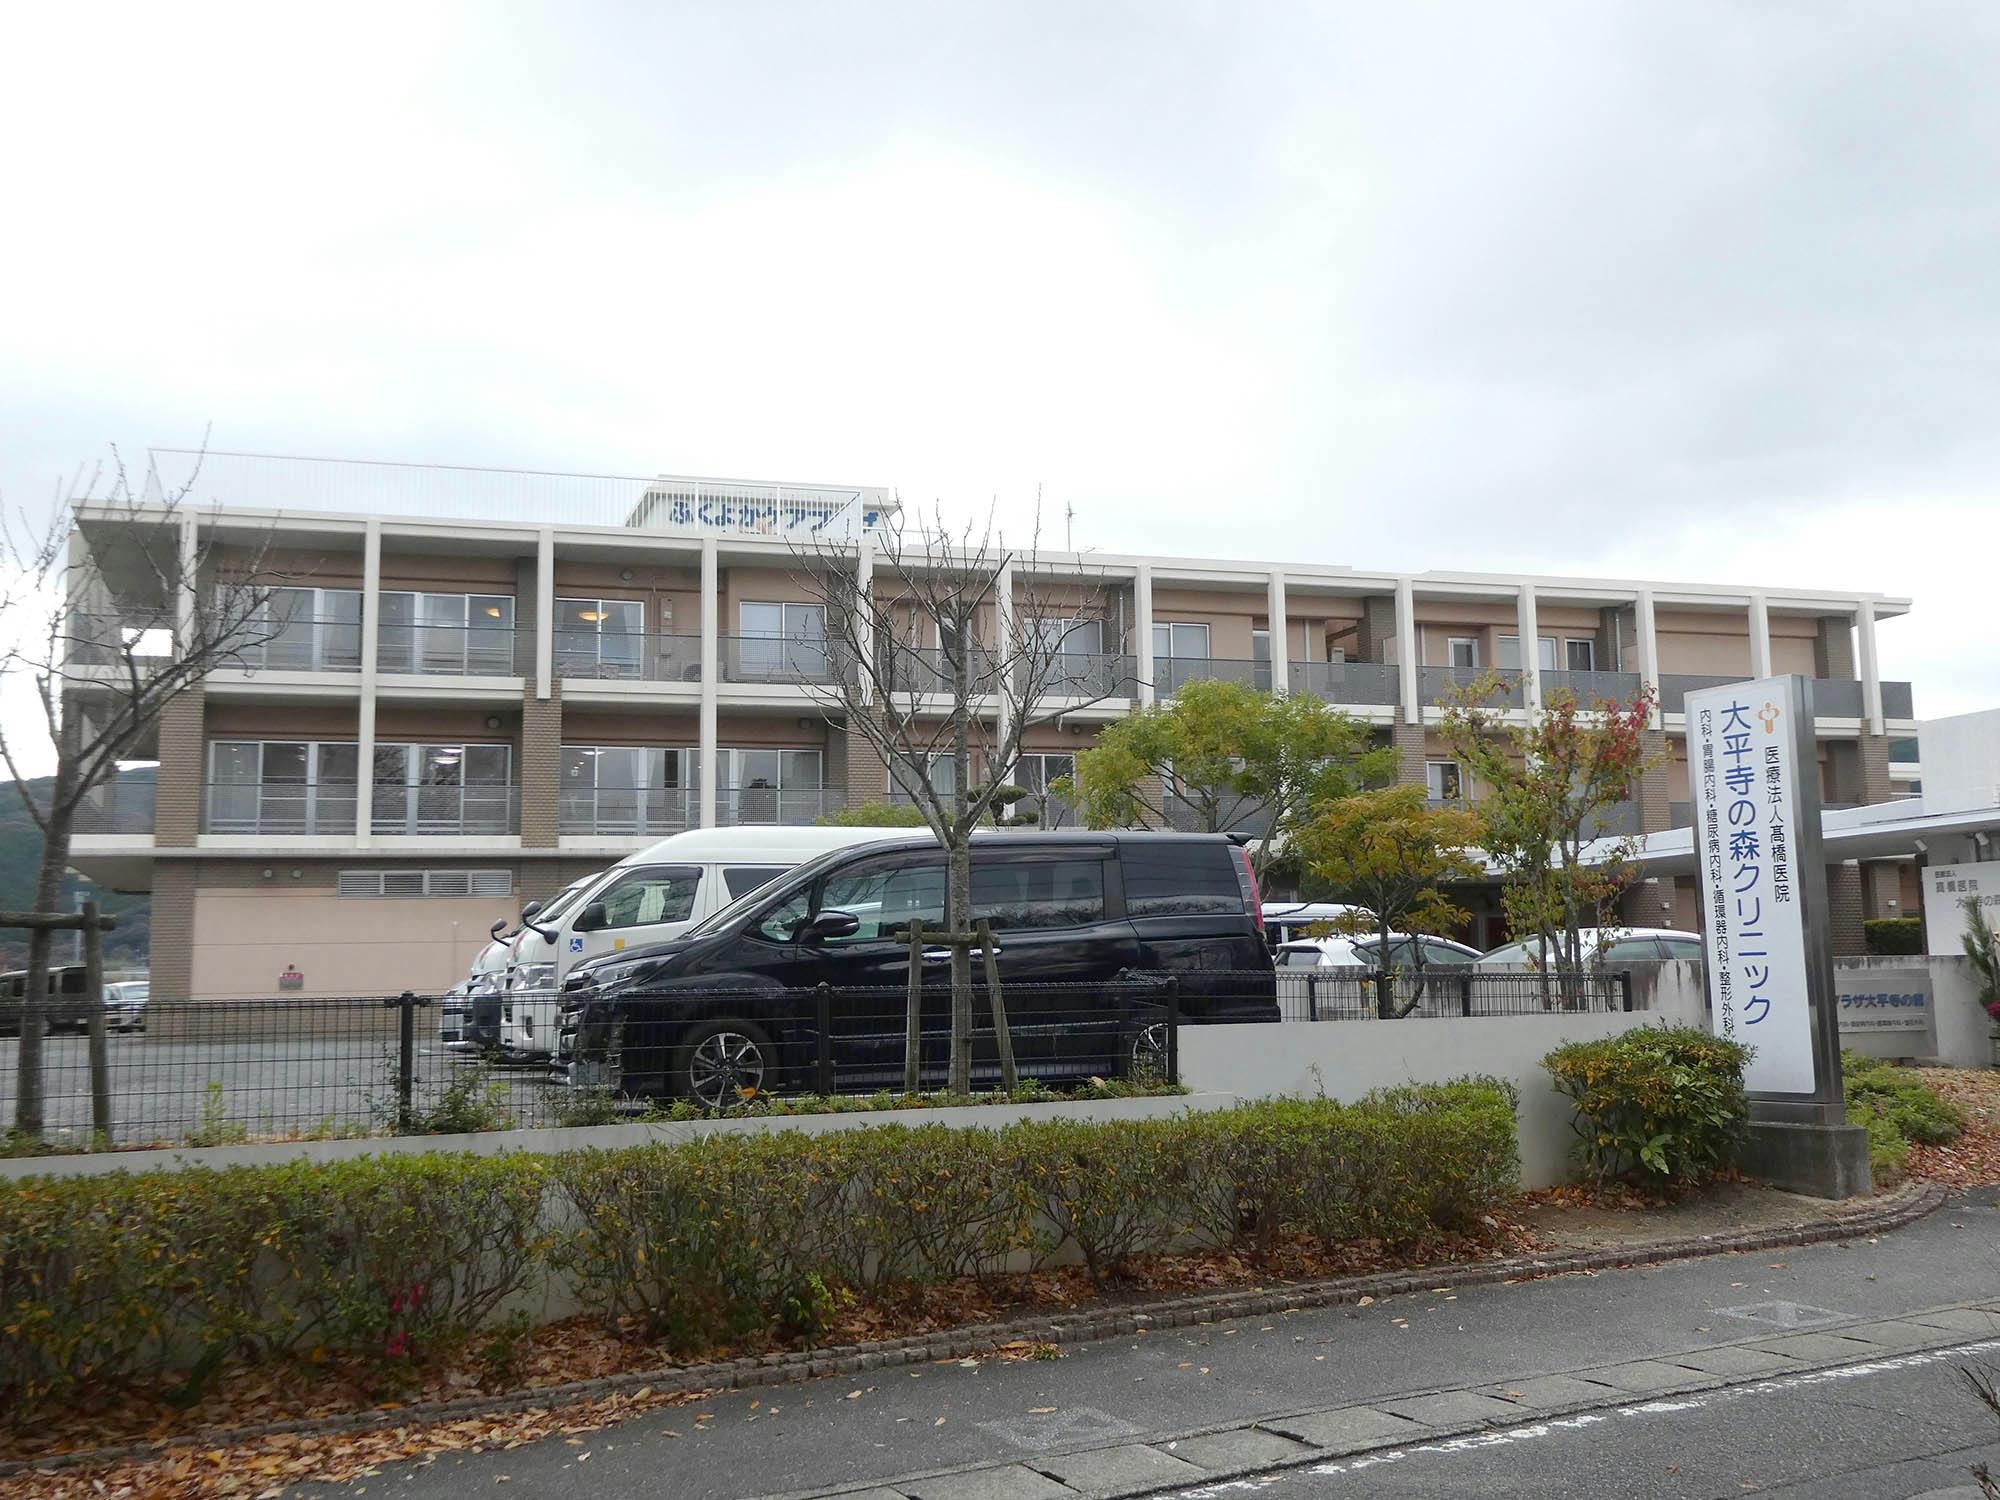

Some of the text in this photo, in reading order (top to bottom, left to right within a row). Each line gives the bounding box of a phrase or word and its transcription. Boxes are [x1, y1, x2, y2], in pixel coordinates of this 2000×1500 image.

[669, 500, 879, 534] ふくよかケアプザ
[1721, 700, 1770, 1025] 大平寺の森クリニック
